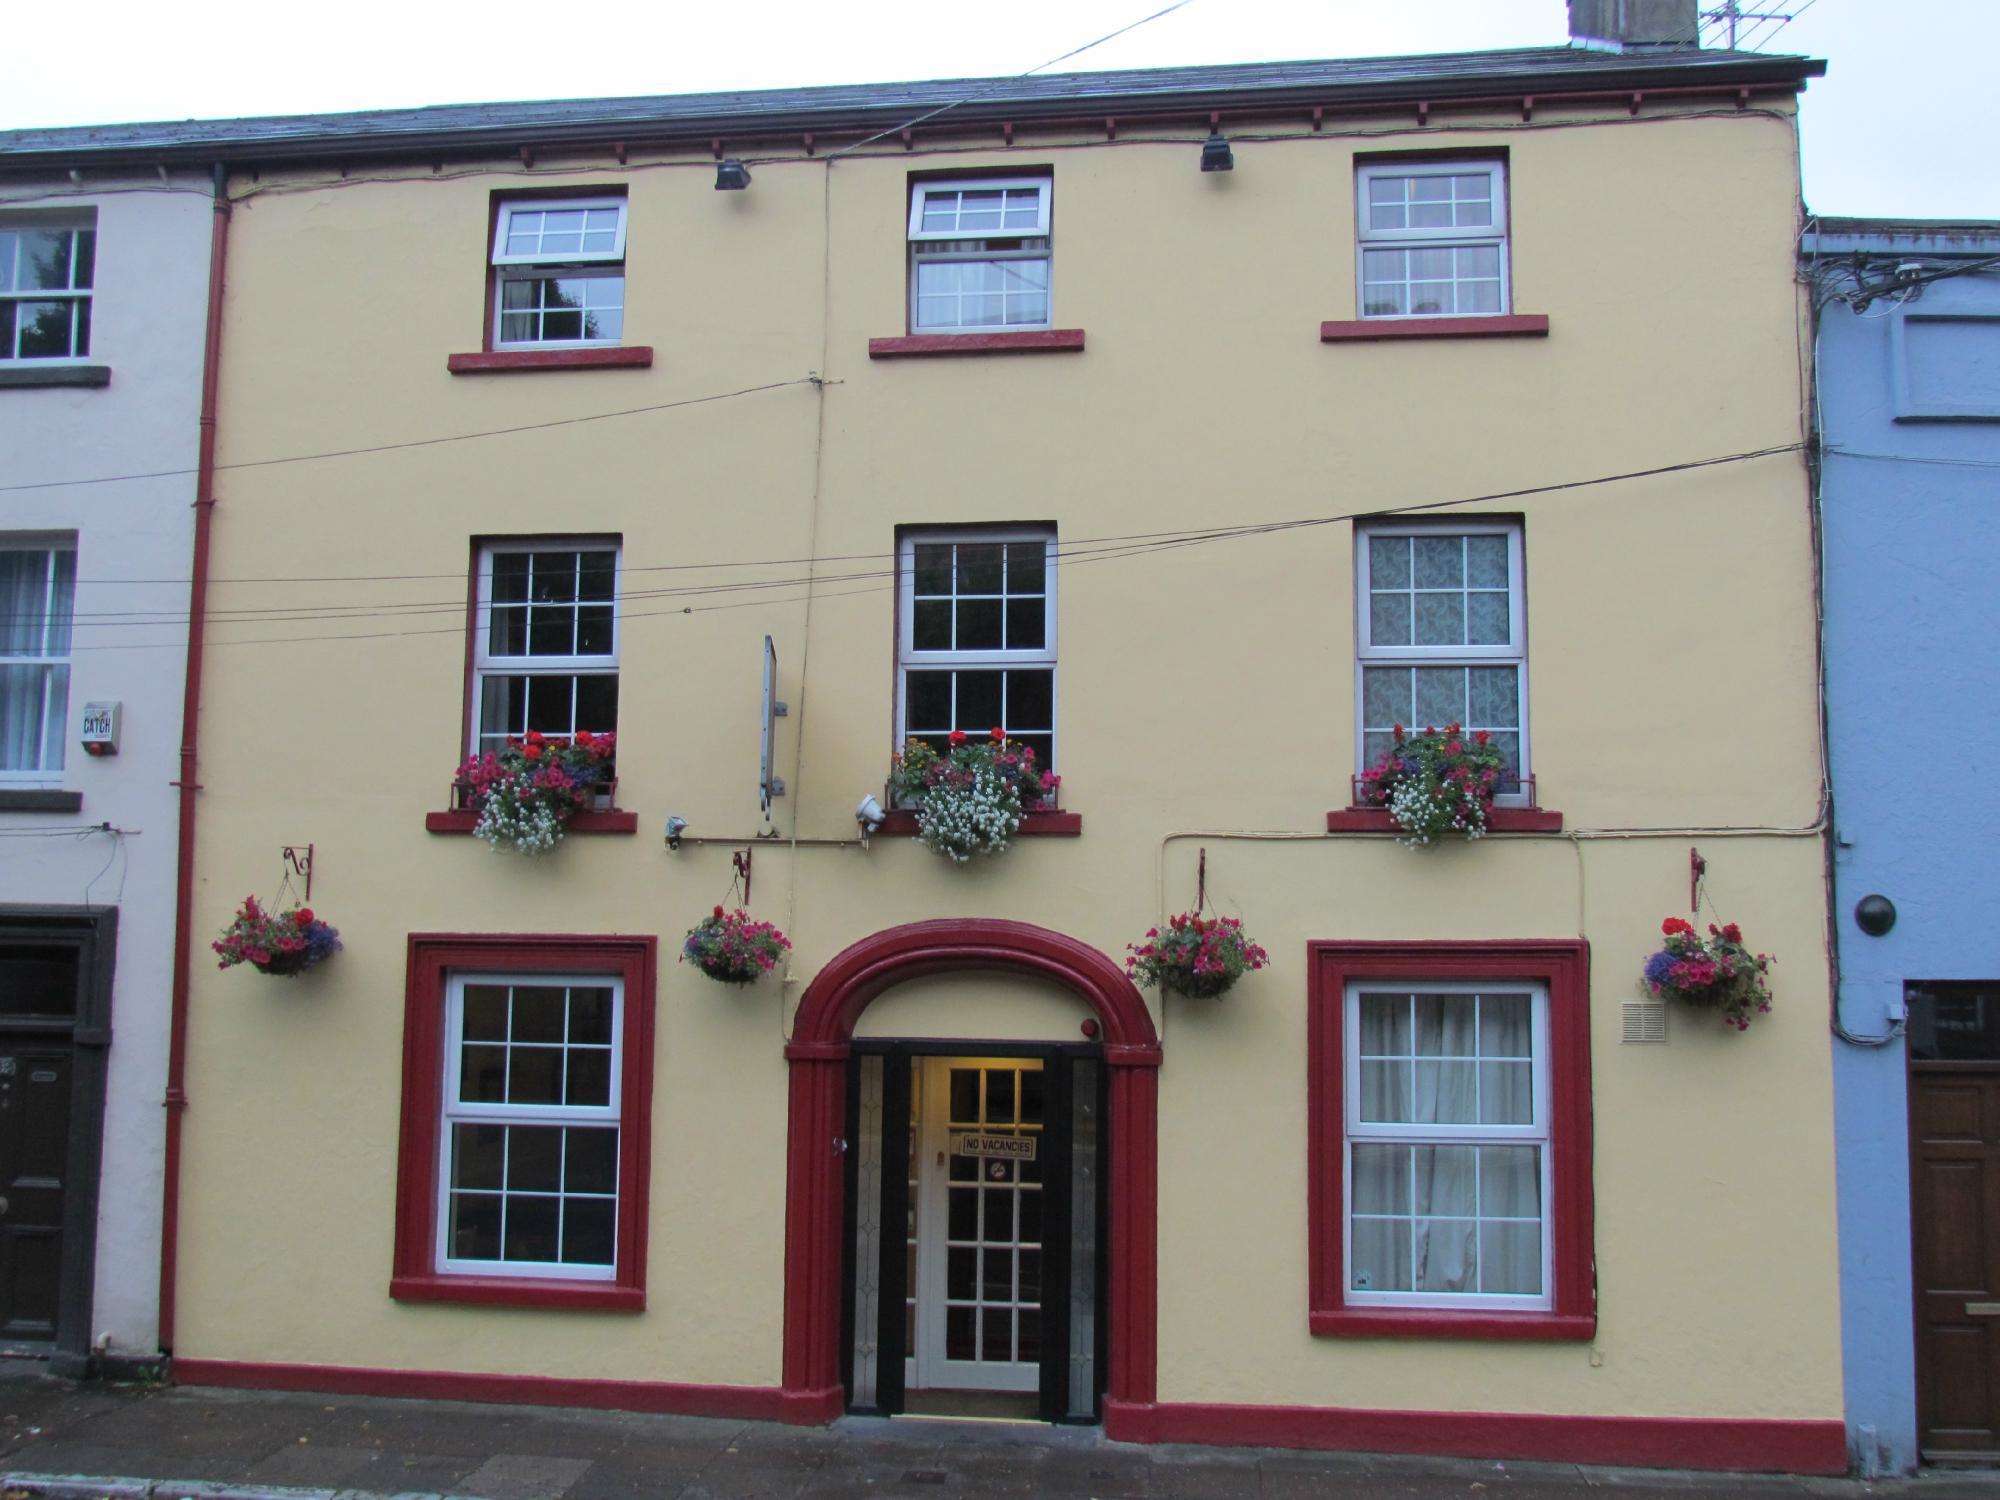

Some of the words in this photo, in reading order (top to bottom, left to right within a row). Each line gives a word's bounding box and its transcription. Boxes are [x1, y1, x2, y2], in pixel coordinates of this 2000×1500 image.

[84, 718, 111, 734] CATCH
[966, 1138, 979, 1149] NO
[982, 1139, 1031, 1152] VACANCIES
